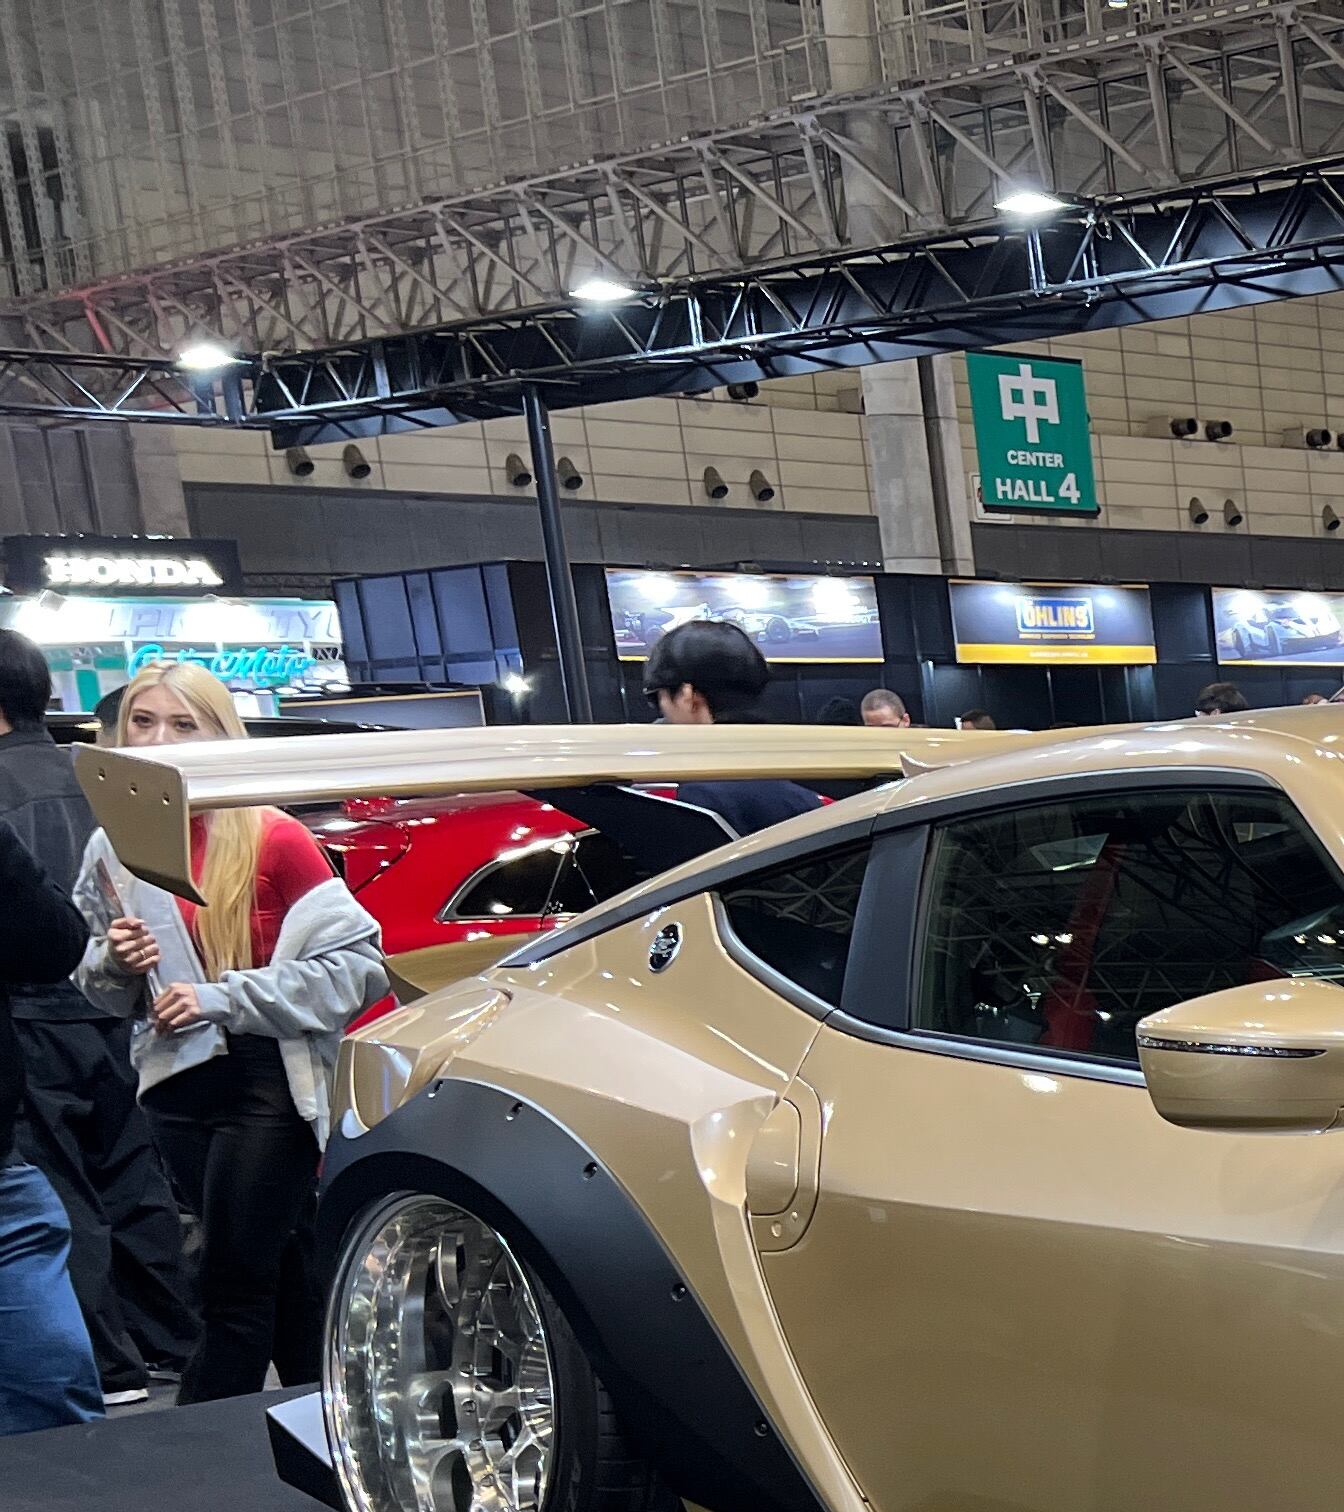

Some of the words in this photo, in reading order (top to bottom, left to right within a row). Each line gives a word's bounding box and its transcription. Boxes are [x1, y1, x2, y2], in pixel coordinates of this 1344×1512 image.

[998, 364, 1060, 443] 中
[1007, 450, 1064, 468] CENTER
[996, 478, 1055, 502] HALL
[1058, 473, 1081, 504] 4
[44, 556, 224, 586] HONDA
